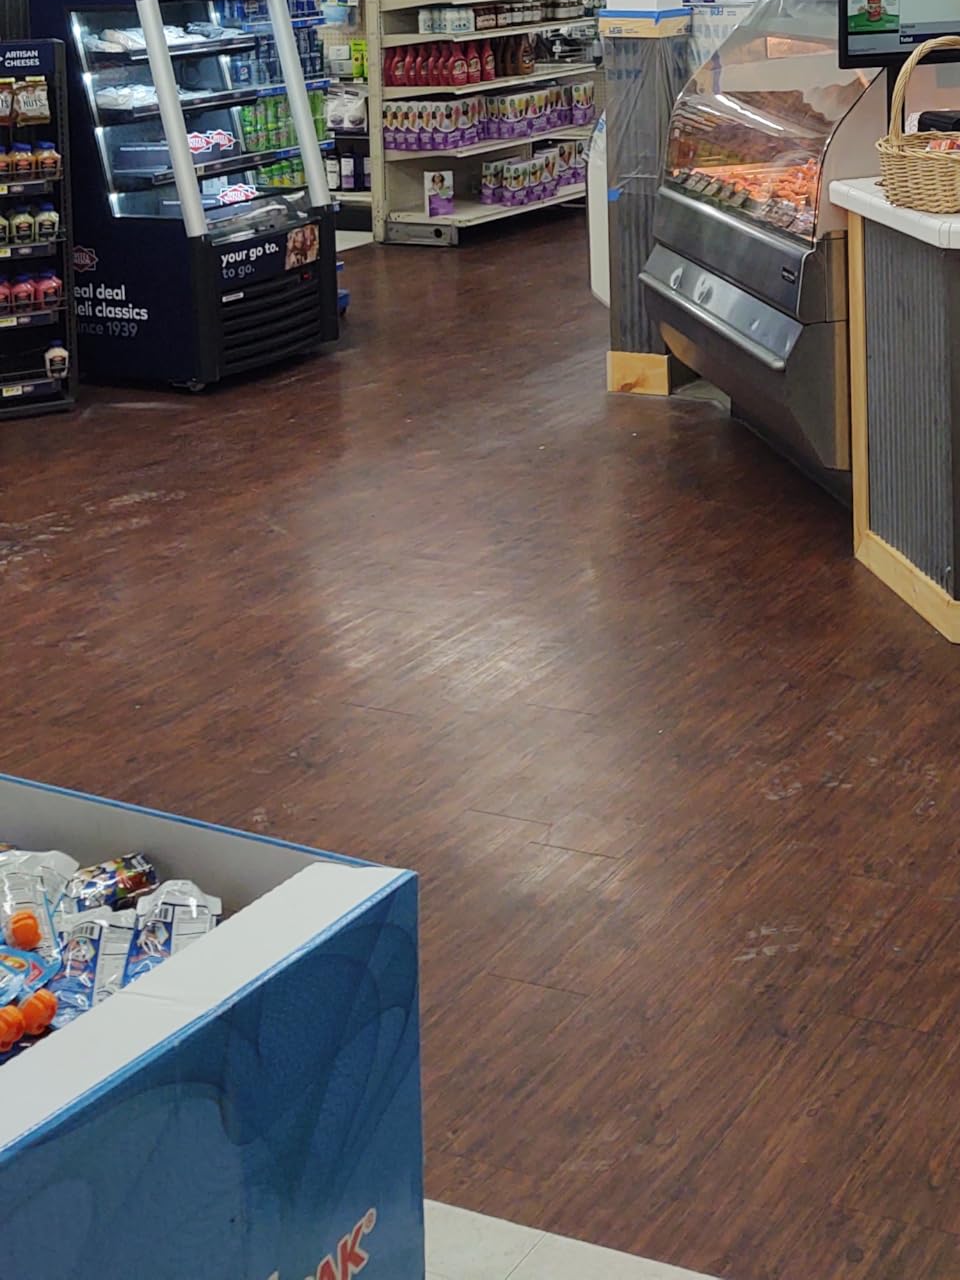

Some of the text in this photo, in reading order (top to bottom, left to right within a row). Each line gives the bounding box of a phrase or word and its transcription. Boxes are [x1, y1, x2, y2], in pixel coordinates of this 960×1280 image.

[4, 58, 40, 67] CHEESES
[5, 50, 39, 58] ARTISAN
[221, 242, 279, 267] your go to.
[222, 263, 256, 279] to go.
[96, 283, 126, 300] deal
[95, 301, 149, 320] classics
[106, 320, 139, 337] 1939
